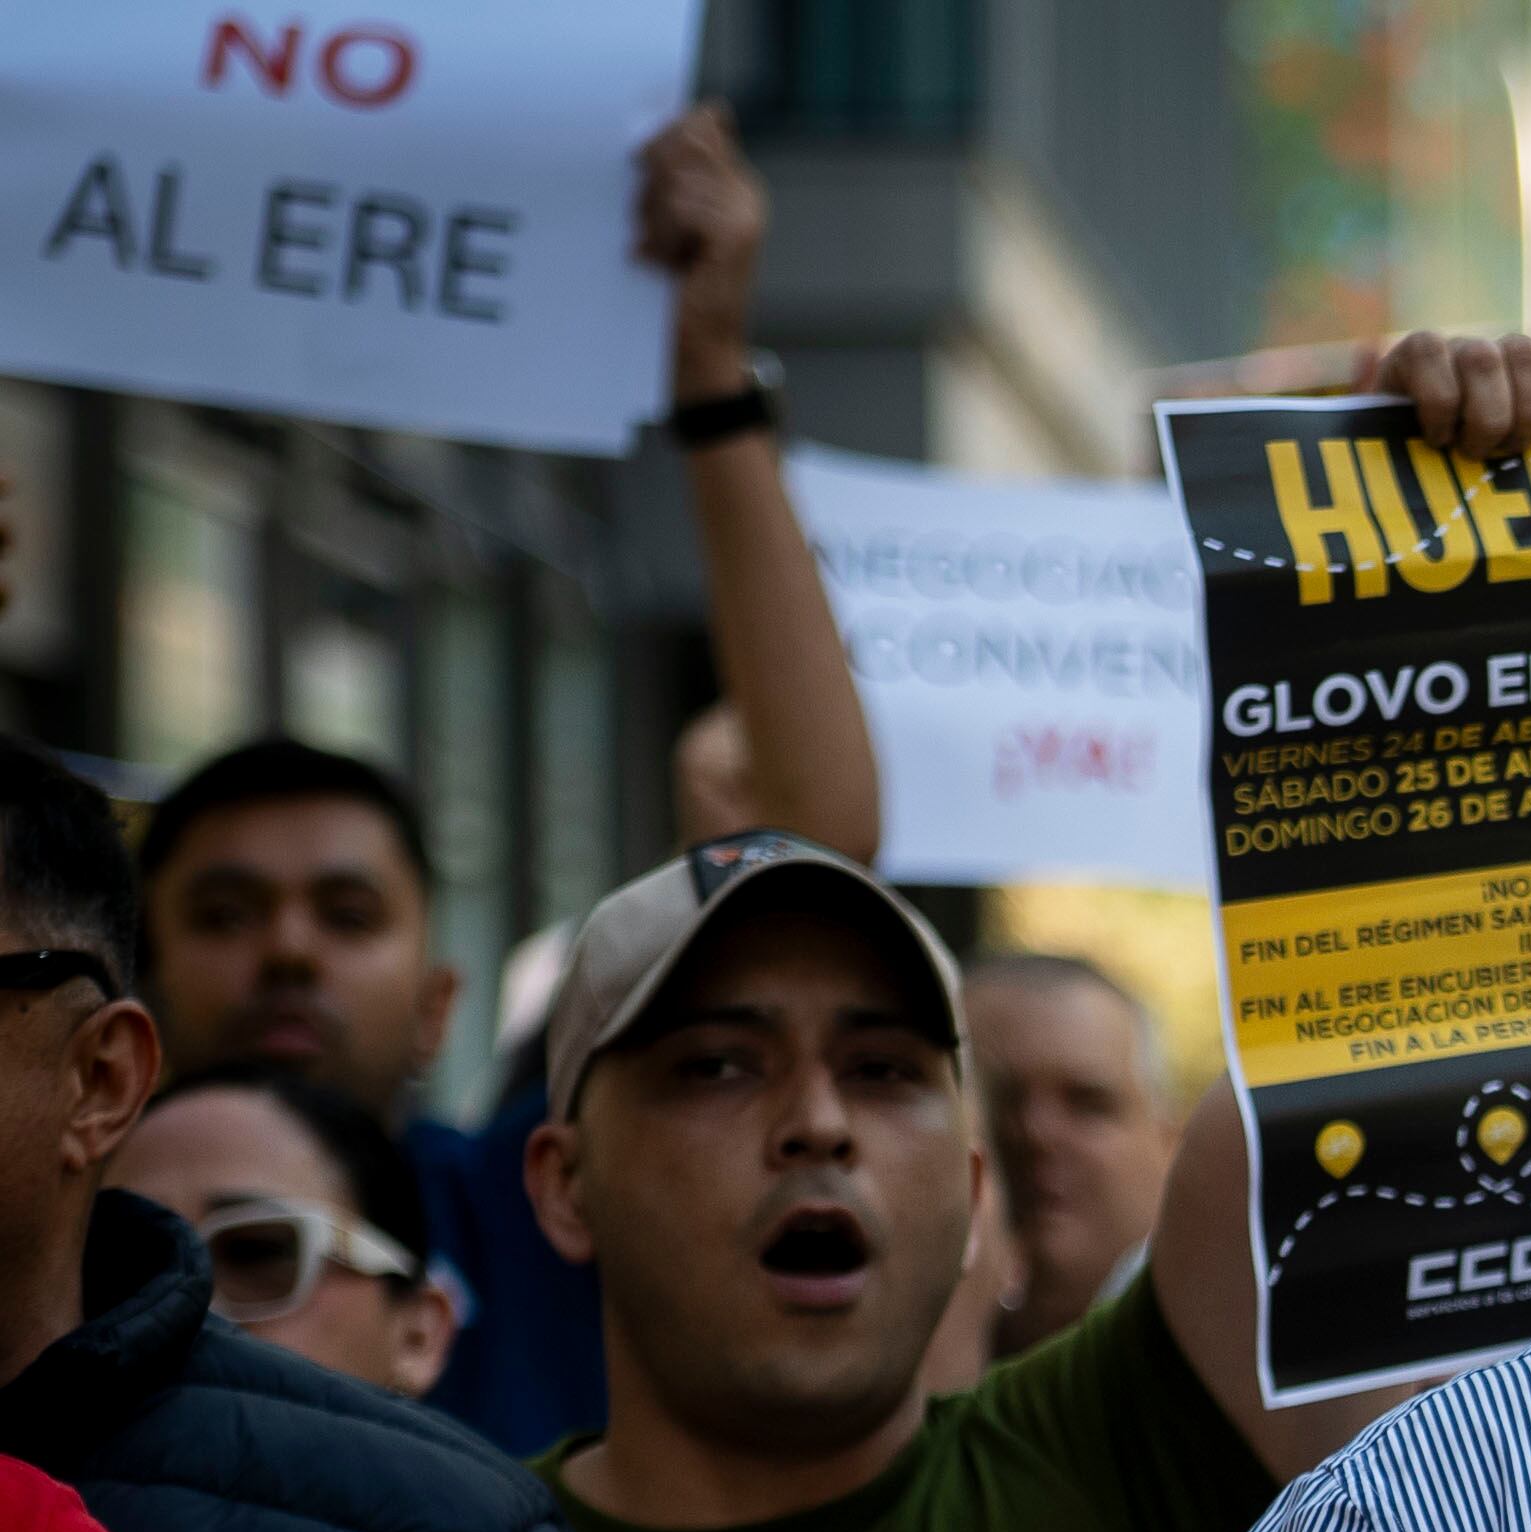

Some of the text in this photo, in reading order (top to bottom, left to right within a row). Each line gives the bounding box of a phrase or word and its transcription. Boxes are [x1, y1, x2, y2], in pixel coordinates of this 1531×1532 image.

[203, 18, 420, 112] NO
[42, 152, 522, 325] AL ERE
[1222, 660, 1470, 738] GLOVO
[1222, 732, 1374, 778] VIERNES
[1382, 729, 1426, 758] 24
[1434, 722, 1484, 752] DE
[1395, 758, 1441, 794] 25
[1446, 750, 1498, 788] DE
[1224, 802, 1402, 857] DOMINGO
[1407, 799, 1454, 833] 26
[1460, 788, 1513, 825] DE
[1240, 936, 1288, 964] FIN
[1295, 929, 1350, 958] DEL
[1357, 909, 1483, 949] RÉGIMEN
[1240, 995, 1287, 1022] FIN
[1295, 990, 1331, 1015] AL
[1339, 979, 1393, 1008] ERE
[1296, 992, 1494, 1043] NEGOCIACIÓN
[1349, 1037, 1397, 1063] FIN
[1406, 1033, 1423, 1052] A
[1431, 1026, 1468, 1050] LA
